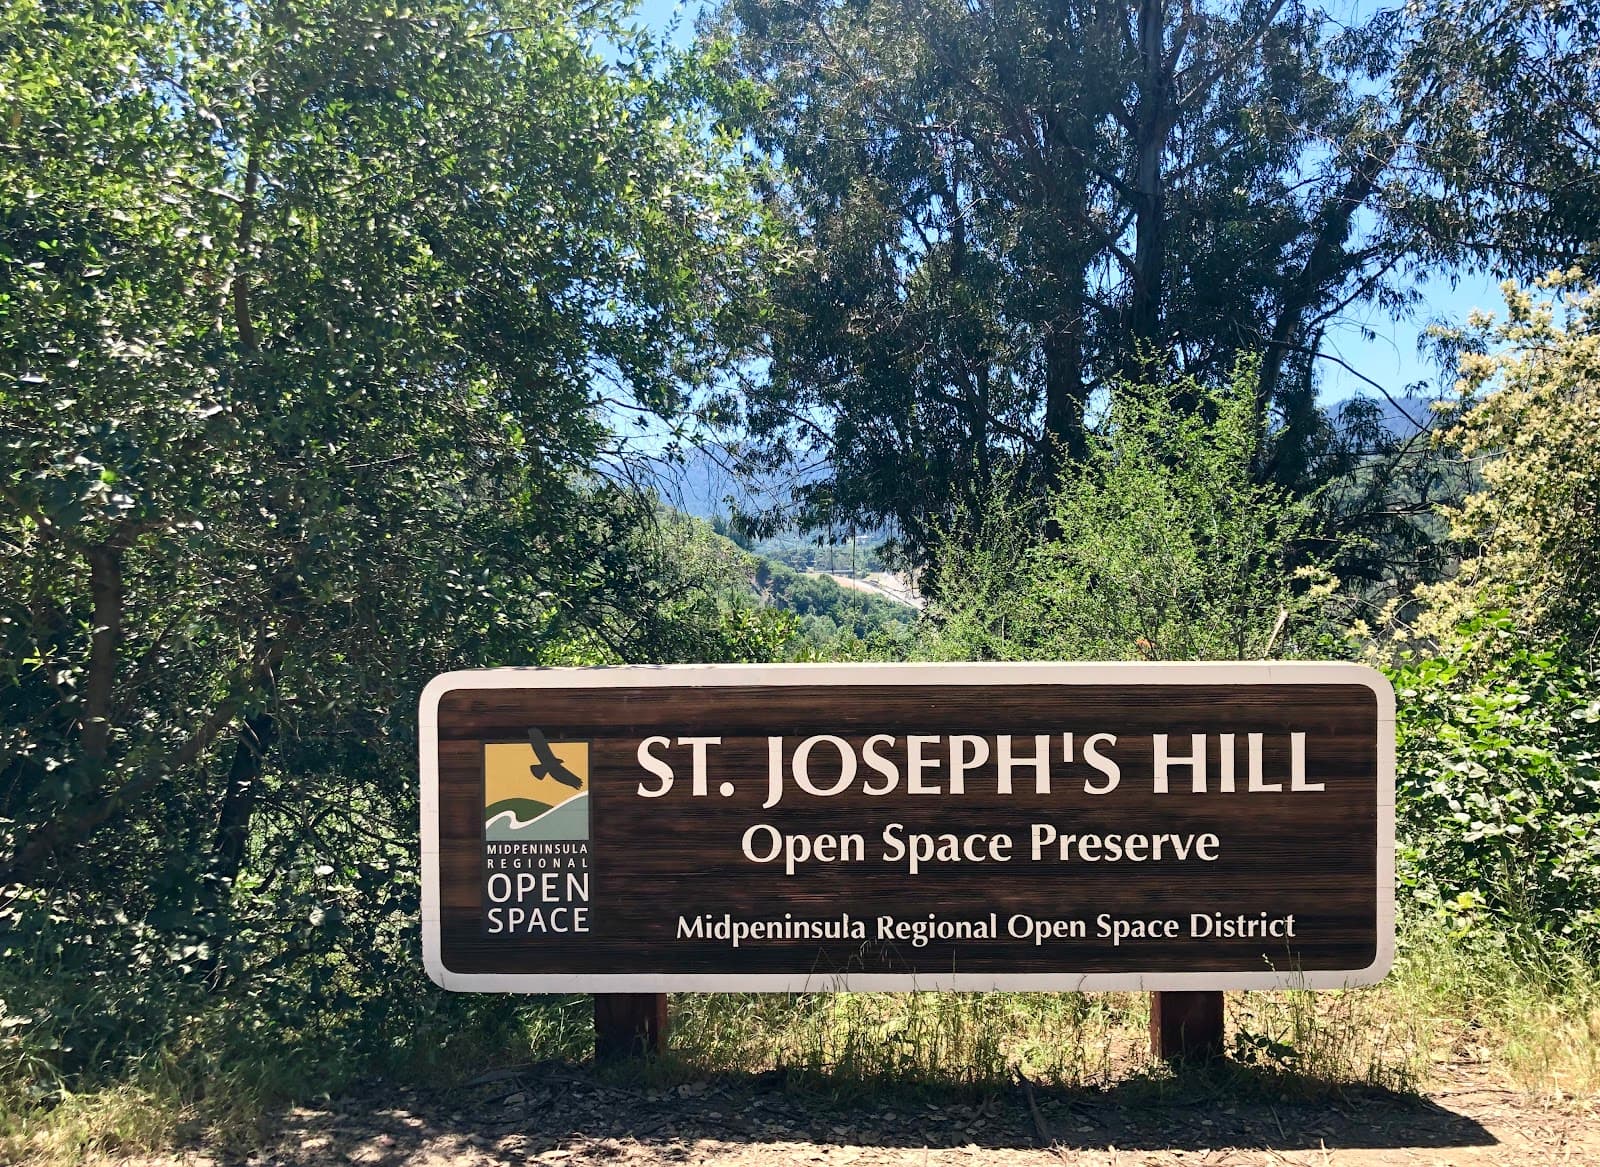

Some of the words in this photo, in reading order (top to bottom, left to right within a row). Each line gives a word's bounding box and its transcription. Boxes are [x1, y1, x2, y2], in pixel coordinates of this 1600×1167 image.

[637, 735, 735, 798] ST.
[763, 732, 1121, 809] JOSEPH'S
[1152, 732, 1326, 794] HILL
[487, 843, 588, 855] MIDPENINSULA
[487, 857, 588, 869] REGIONAL
[741, 824, 865, 875] Open
[882, 823, 1013, 875] Space
[1031, 823, 1220, 862] Preserve
[487, 872, 589, 903] OPEN
[487, 907, 590, 933] SPACE
[676, 912, 866, 948] Midpeninsula
[877, 912, 997, 948] Regional
[1007, 914, 1086, 946] Open
[1096, 913, 1179, 946] Space
[1190, 911, 1296, 938] District
